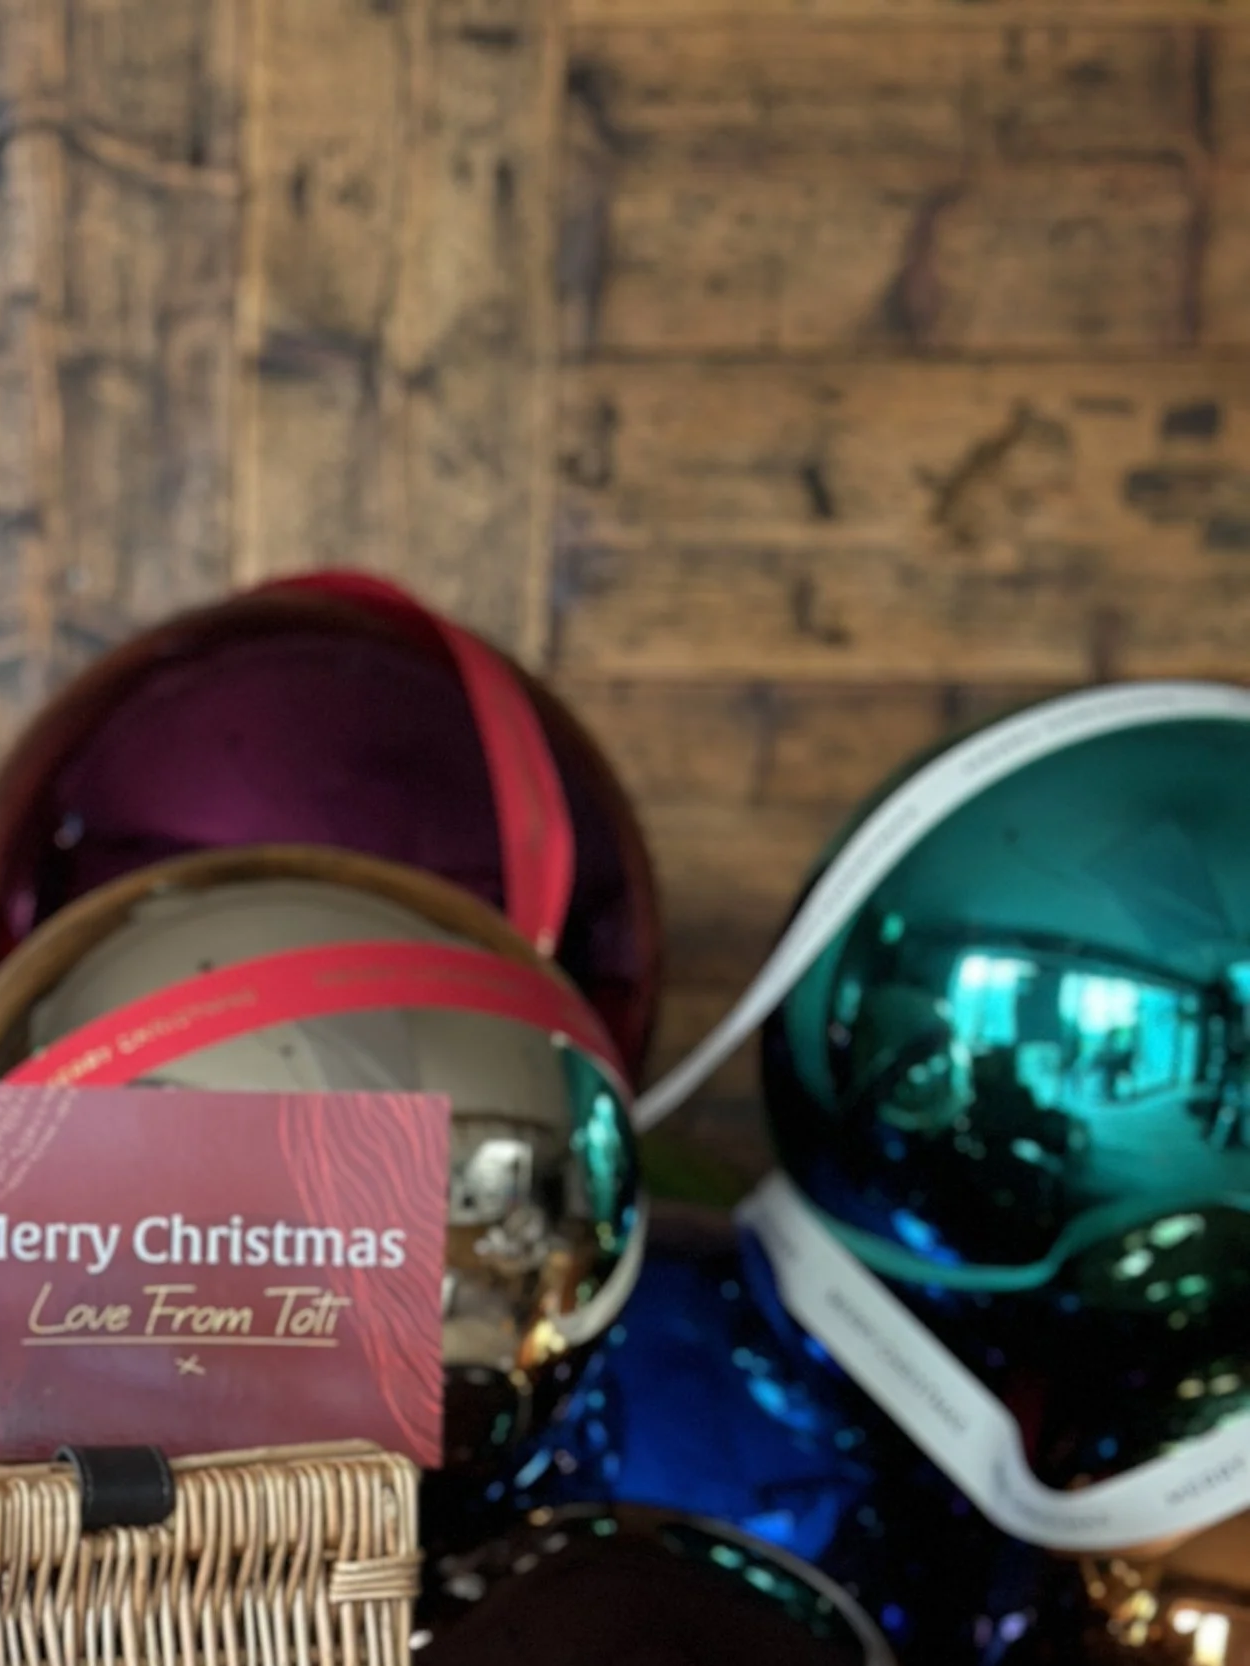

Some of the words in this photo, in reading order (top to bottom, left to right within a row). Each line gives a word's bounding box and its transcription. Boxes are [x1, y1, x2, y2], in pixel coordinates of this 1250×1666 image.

[132, 1215, 406, 1267] Christmas
[28, 1282, 129, 1335] Love
[142, 1284, 252, 1336] From
